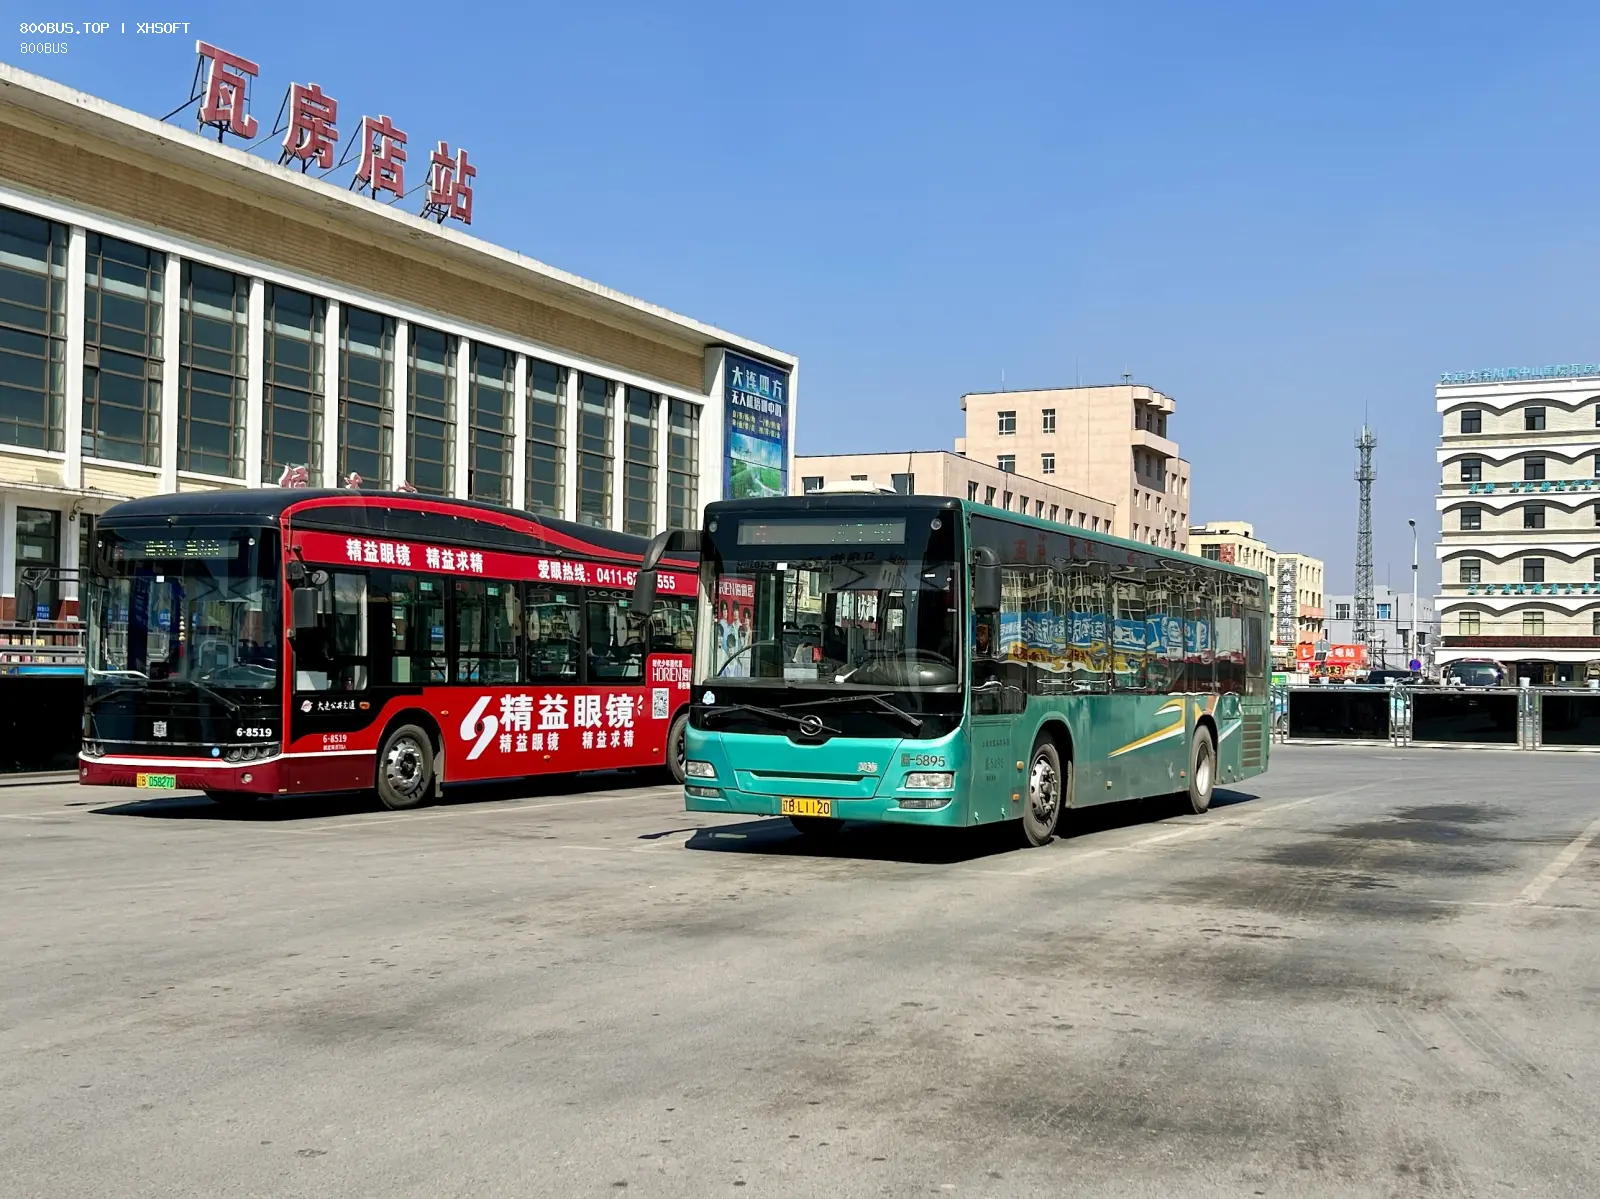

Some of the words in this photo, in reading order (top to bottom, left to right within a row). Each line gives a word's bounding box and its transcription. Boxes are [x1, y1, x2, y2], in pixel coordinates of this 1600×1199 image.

[195, 39, 477, 225] 瓦房店站
[732, 366, 782, 400] 大连四方
[346, 538, 411, 567] 精益眼镜
[425, 546, 483, 574] 精益求精
[499, 693, 635, 731] 精益眼镜
[236, 728, 272, 738] 6-8519
[322, 734, 348, 744] 6-8519
[499, 731, 560, 753] 精益眼镜
[582, 730, 635, 750] 精益求精
